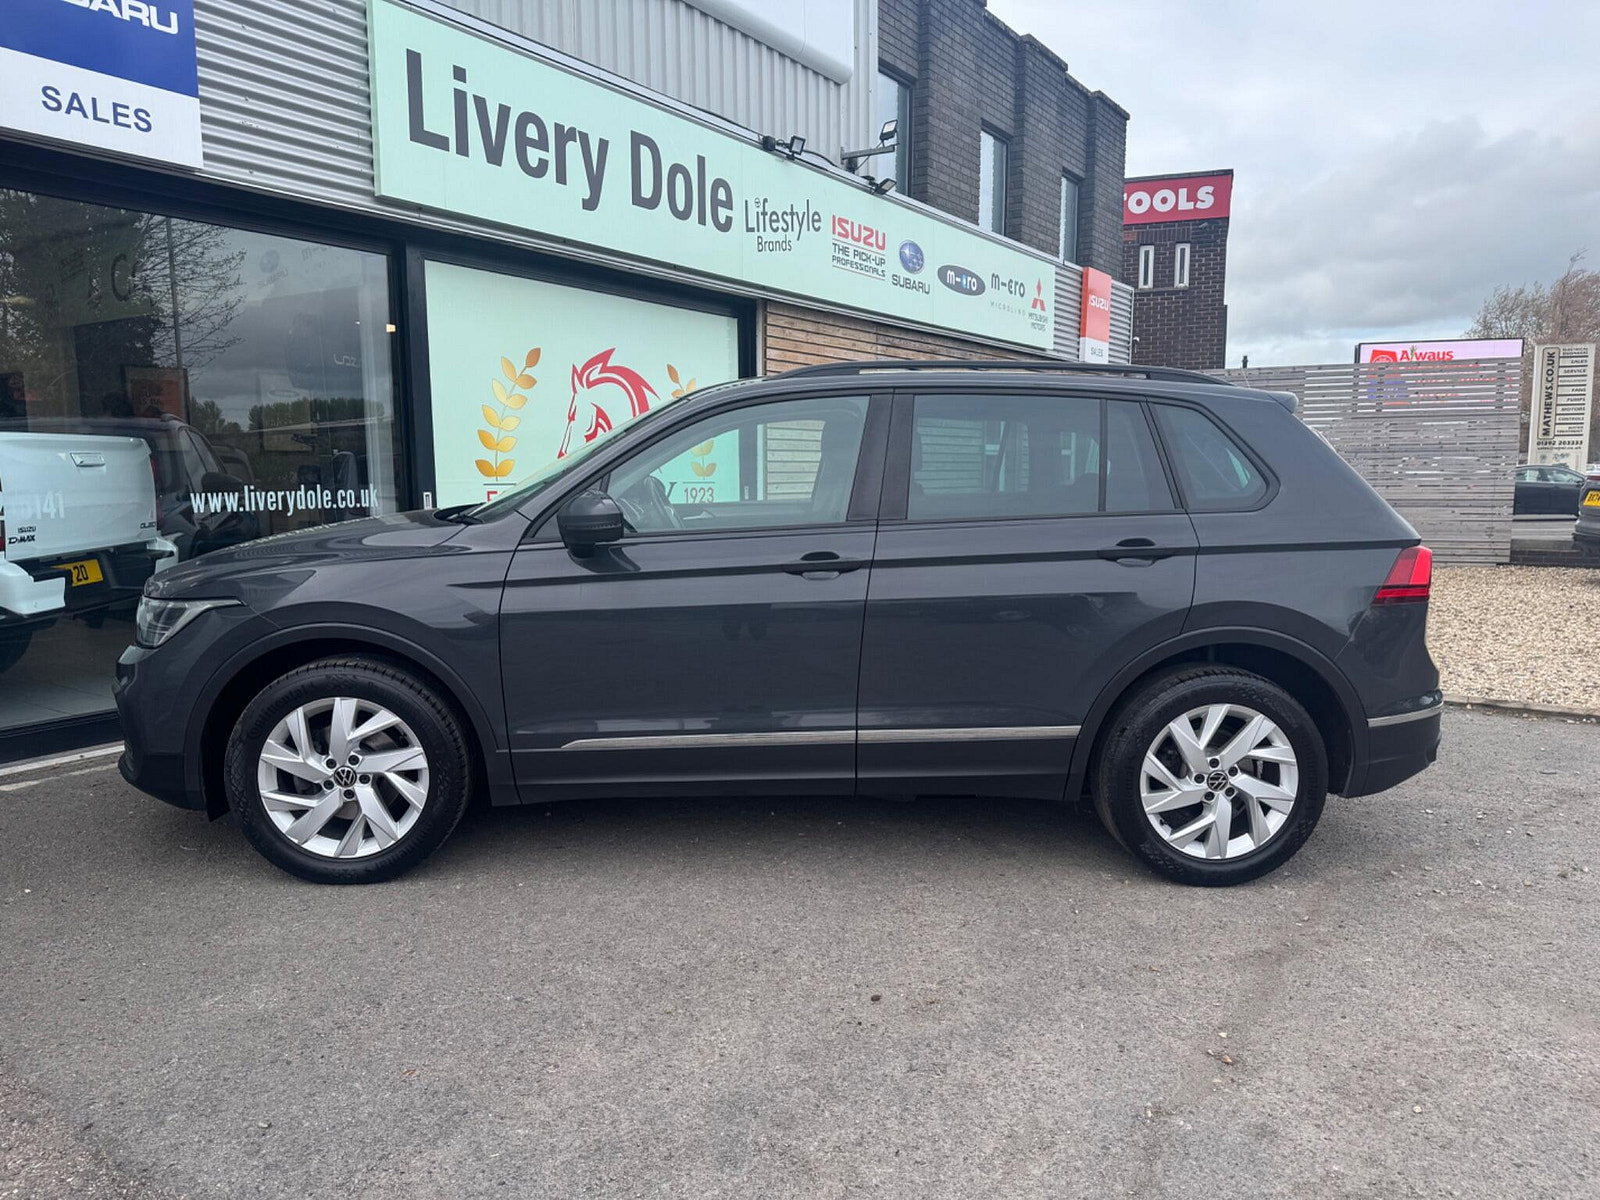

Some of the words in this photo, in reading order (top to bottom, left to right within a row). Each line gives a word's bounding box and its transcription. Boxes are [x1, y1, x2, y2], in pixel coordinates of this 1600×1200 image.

[41, 85, 153, 133] SALES
[406, 48, 609, 211] Livery
[630, 129, 734, 233] Dole
[744, 197, 822, 241] Lifestyle
[832, 214, 885, 250] ISUZU
[756, 234, 792, 253] Brands
[832, 242, 850, 257] THE
[853, 248, 886, 268] PICK-UP
[832, 254, 886, 278] PROFESSIONALS
[891, 273, 931, 295] SUBARU
[1088, 294, 1109, 311] ISUZU
[1542, 351, 1555, 437] MATHEWS.CO.UK
[190, 483, 379, 517] www.liverydole.co.uk
